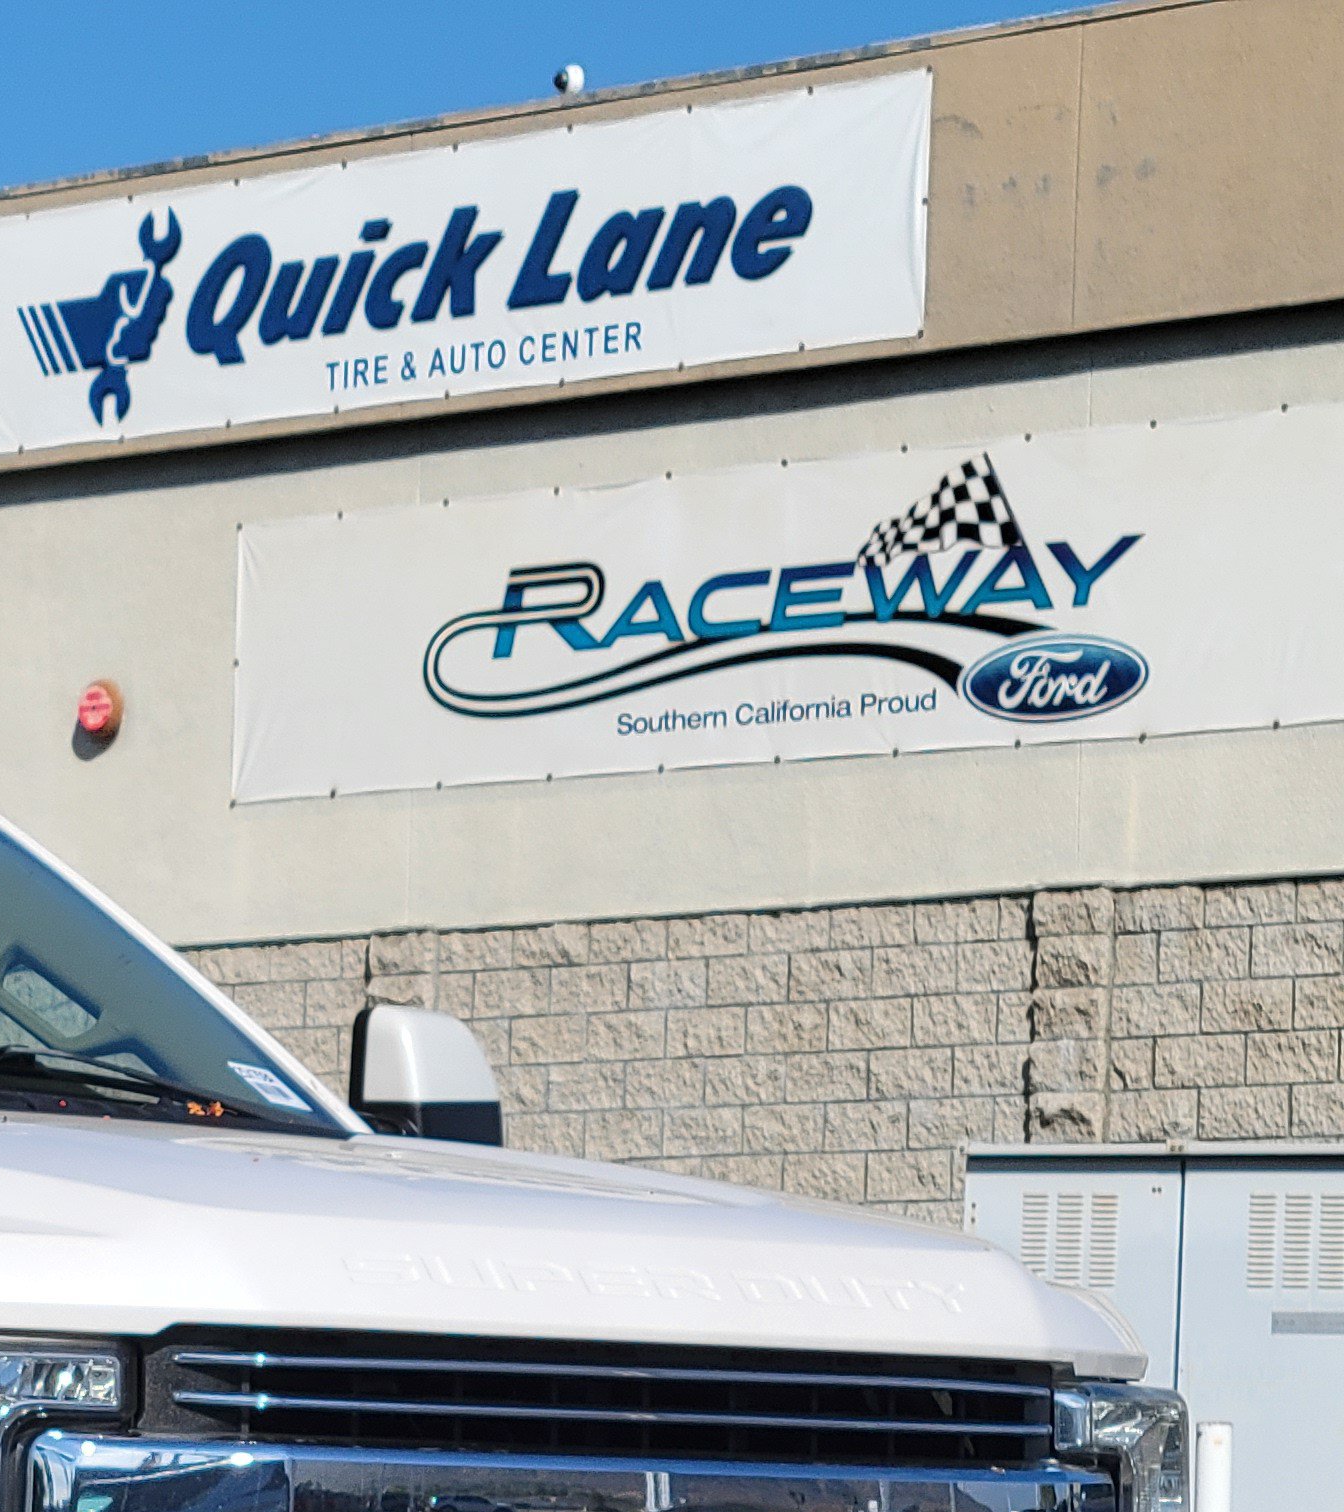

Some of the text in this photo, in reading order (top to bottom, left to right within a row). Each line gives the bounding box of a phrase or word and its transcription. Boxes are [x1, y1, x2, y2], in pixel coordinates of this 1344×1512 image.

[184, 184, 815, 367] Quick Lane
[326, 321, 642, 391] TIRE & AUTO CENTER
[492, 533, 1145, 660] RACEWAY
[616, 688, 937, 736] Southern California Proud
[997, 649, 1112, 710] Ford
[341, 1254, 966, 1314] SUPER DUTY
